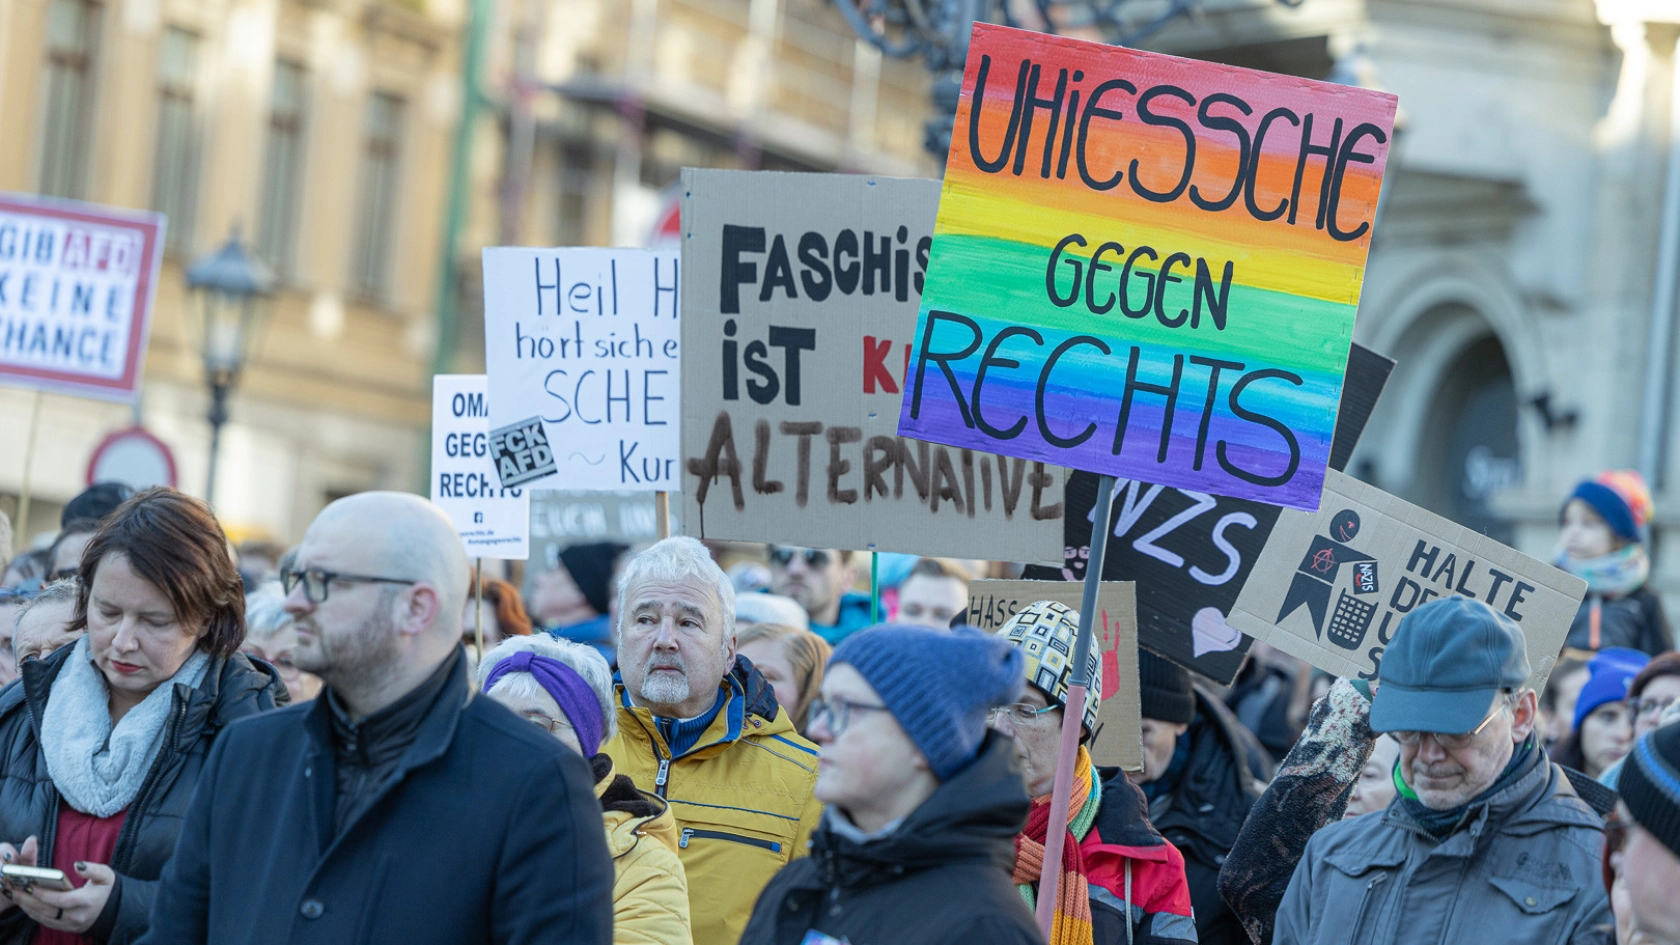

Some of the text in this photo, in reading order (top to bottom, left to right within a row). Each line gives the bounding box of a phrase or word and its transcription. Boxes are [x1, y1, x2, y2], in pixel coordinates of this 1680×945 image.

[0, 226, 54, 263] GIB
[535, 257, 618, 317] Heil
[1046, 233, 1234, 331] GEGEN
[0, 314, 118, 368] HANCE
[515, 320, 584, 359] hört
[594, 323, 653, 359] sich
[862, 335, 911, 395] K
[540, 369, 669, 426] SCHE
[910, 310, 1304, 487] RECHTS
[490, 421, 547, 460] FCK
[501, 444, 554, 480] AFD
[1359, 563, 1374, 592] NAZIS
[1406, 539, 1536, 622] HALTE
[969, 594, 1019, 629] HASS
